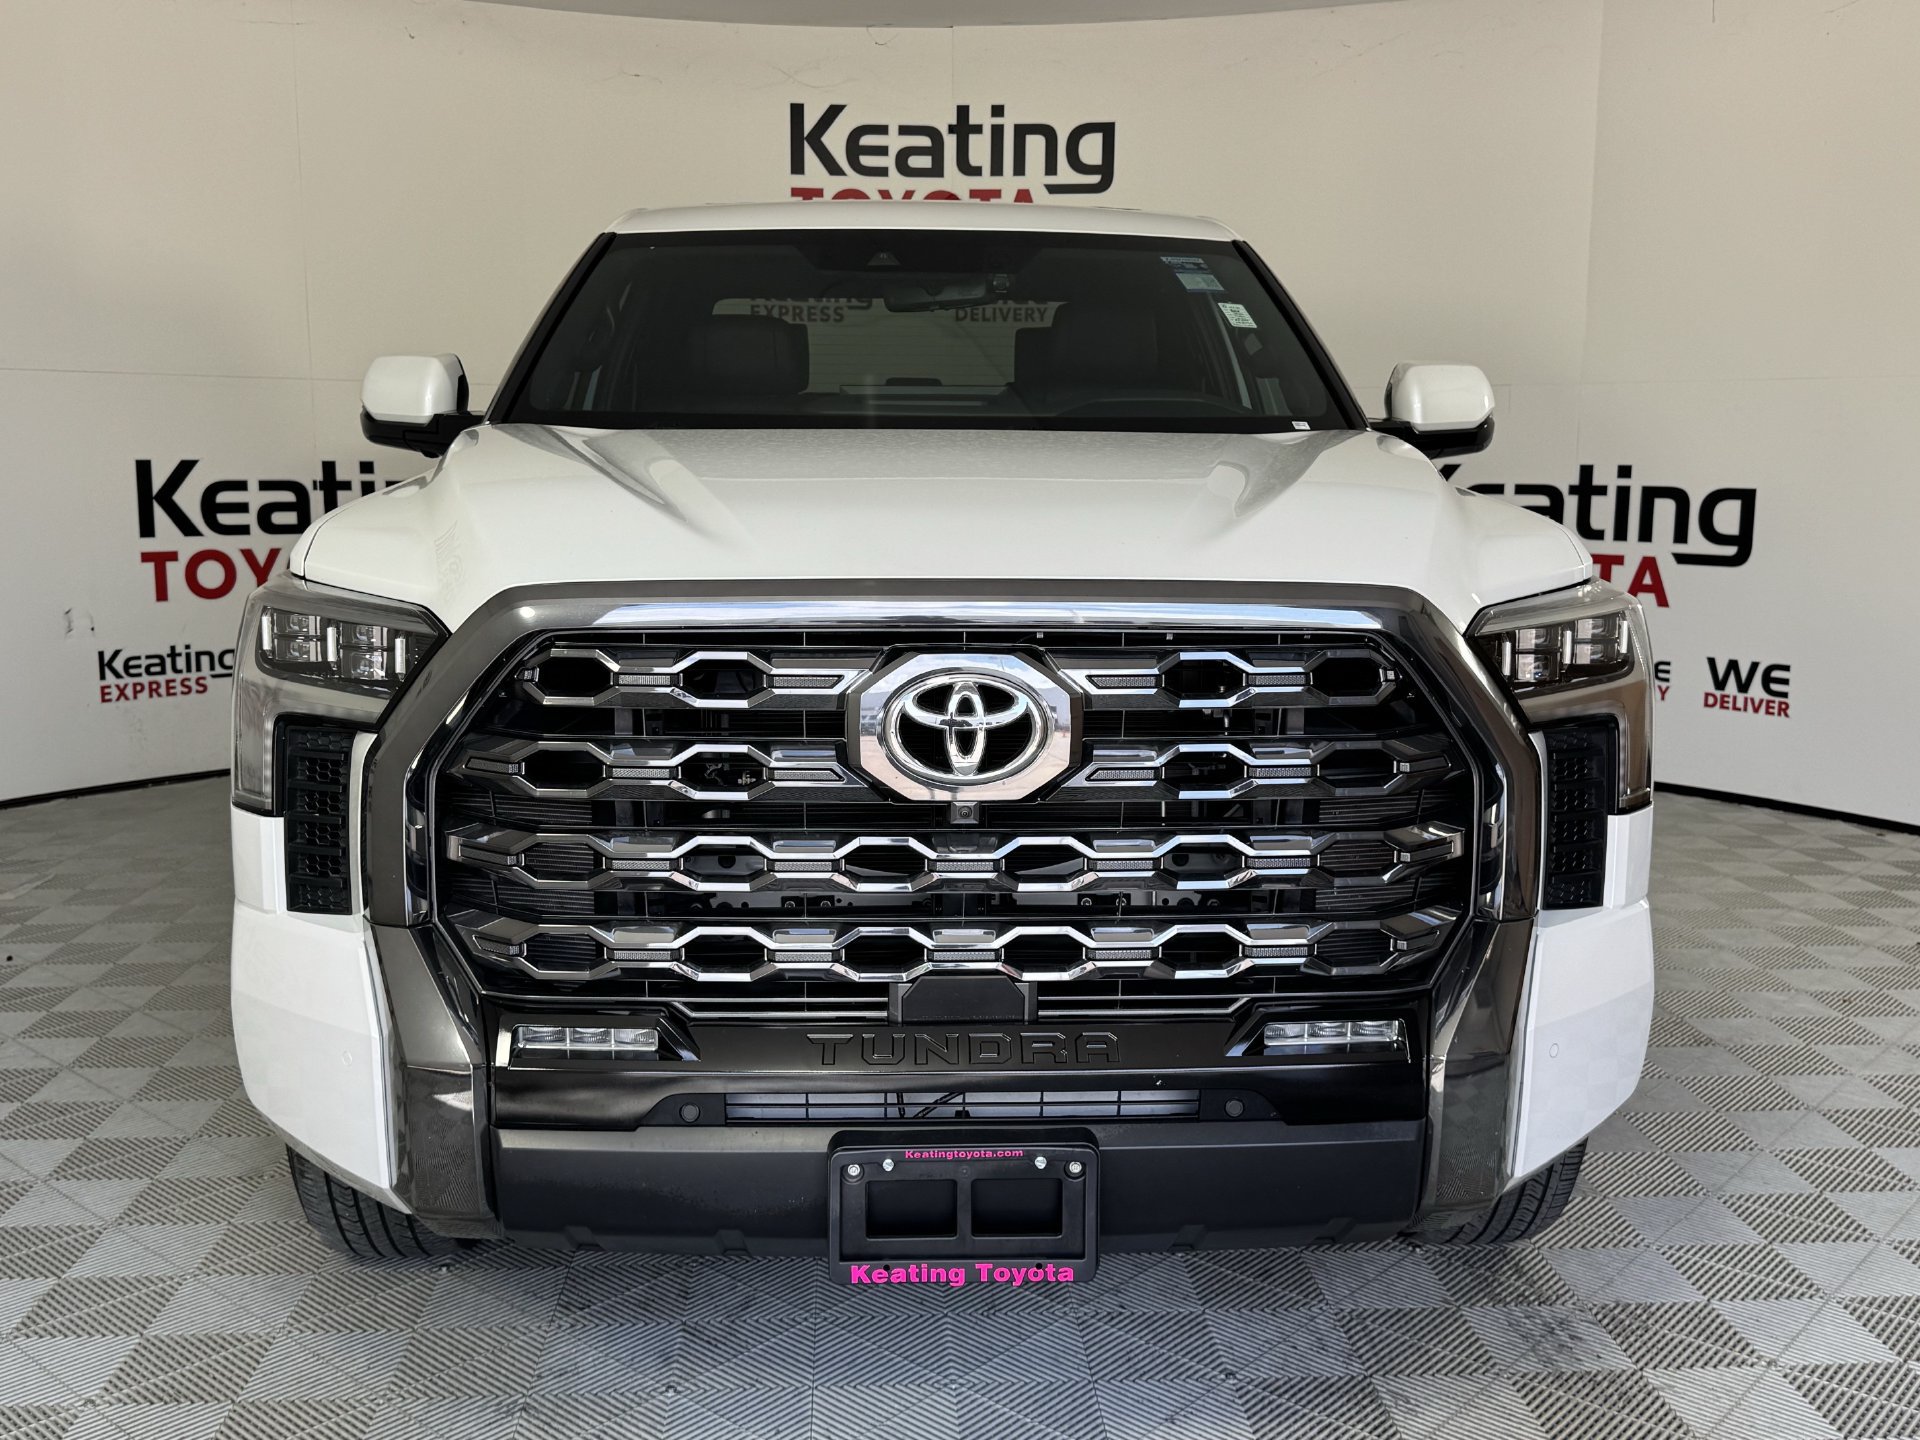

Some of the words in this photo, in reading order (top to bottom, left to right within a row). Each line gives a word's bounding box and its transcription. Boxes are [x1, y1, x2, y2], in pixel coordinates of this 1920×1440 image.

[790, 102, 1116, 195] Keating
[955, 307, 1048, 323] DELIVERY
[99, 676, 209, 704] EXPRESS
[1705, 656, 1791, 699] WE
[1703, 691, 1790, 718] DELIVER
[806, 1031, 1121, 1066] TUNDRA
[904, 1149, 1024, 1161] Keatingtoyota.com
[849, 1262, 966, 1288] Keating
[975, 1262, 1075, 1287] Toyota
